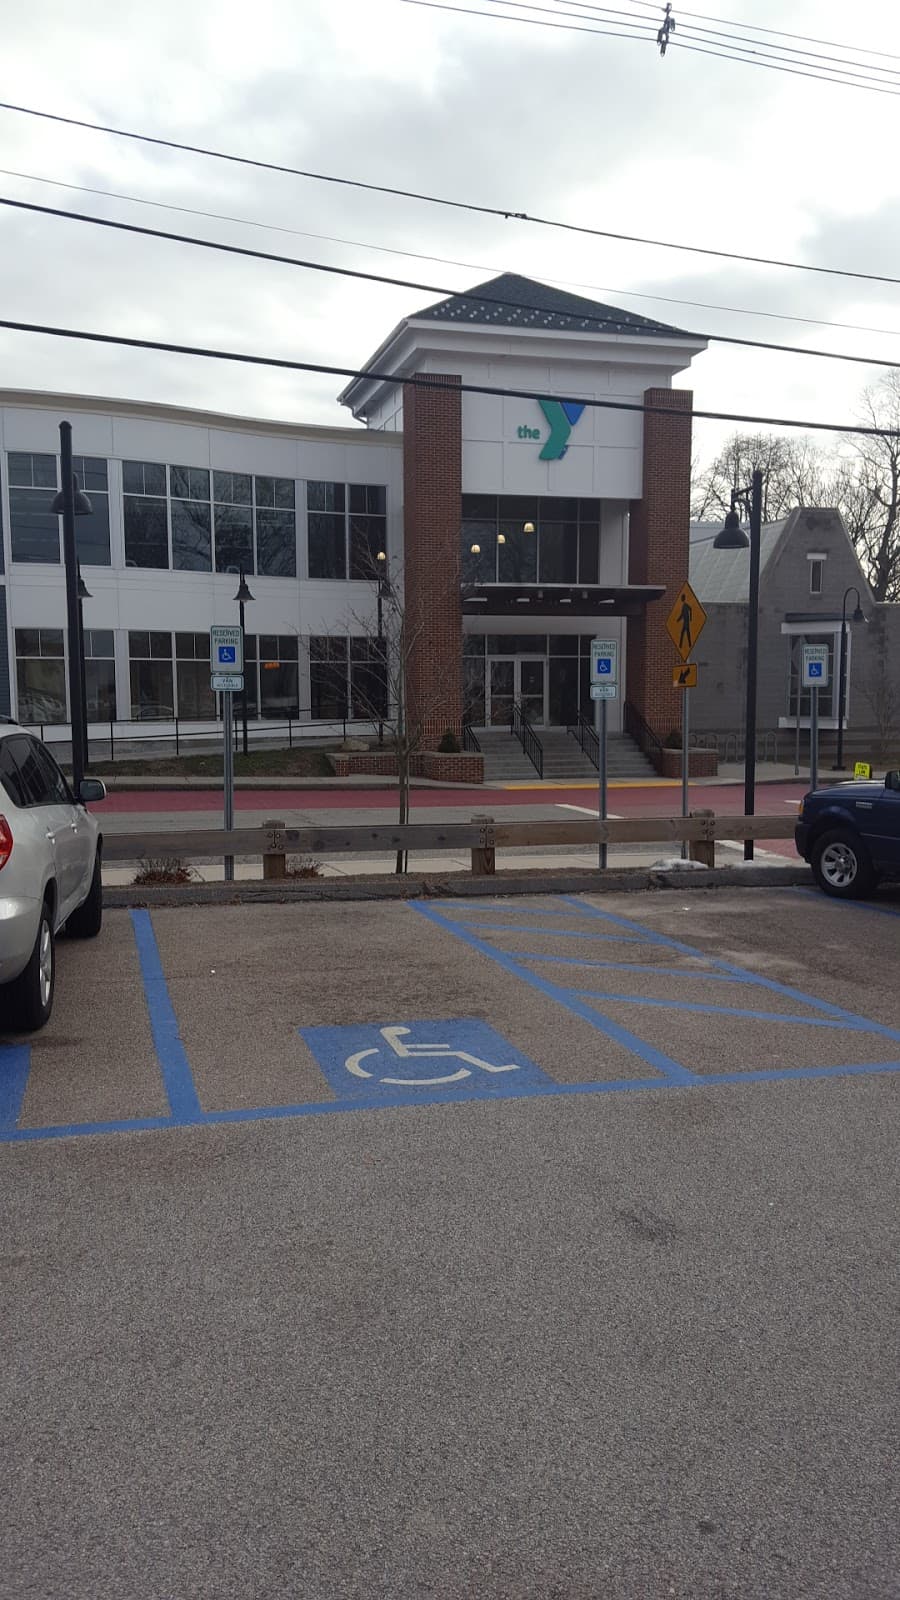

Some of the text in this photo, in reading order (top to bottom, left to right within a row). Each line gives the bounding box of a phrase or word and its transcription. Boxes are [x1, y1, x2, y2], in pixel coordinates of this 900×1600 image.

[517, 424, 541, 440] the
[212, 629, 240, 637] RESERVED
[214, 637, 239, 645] PARKING
